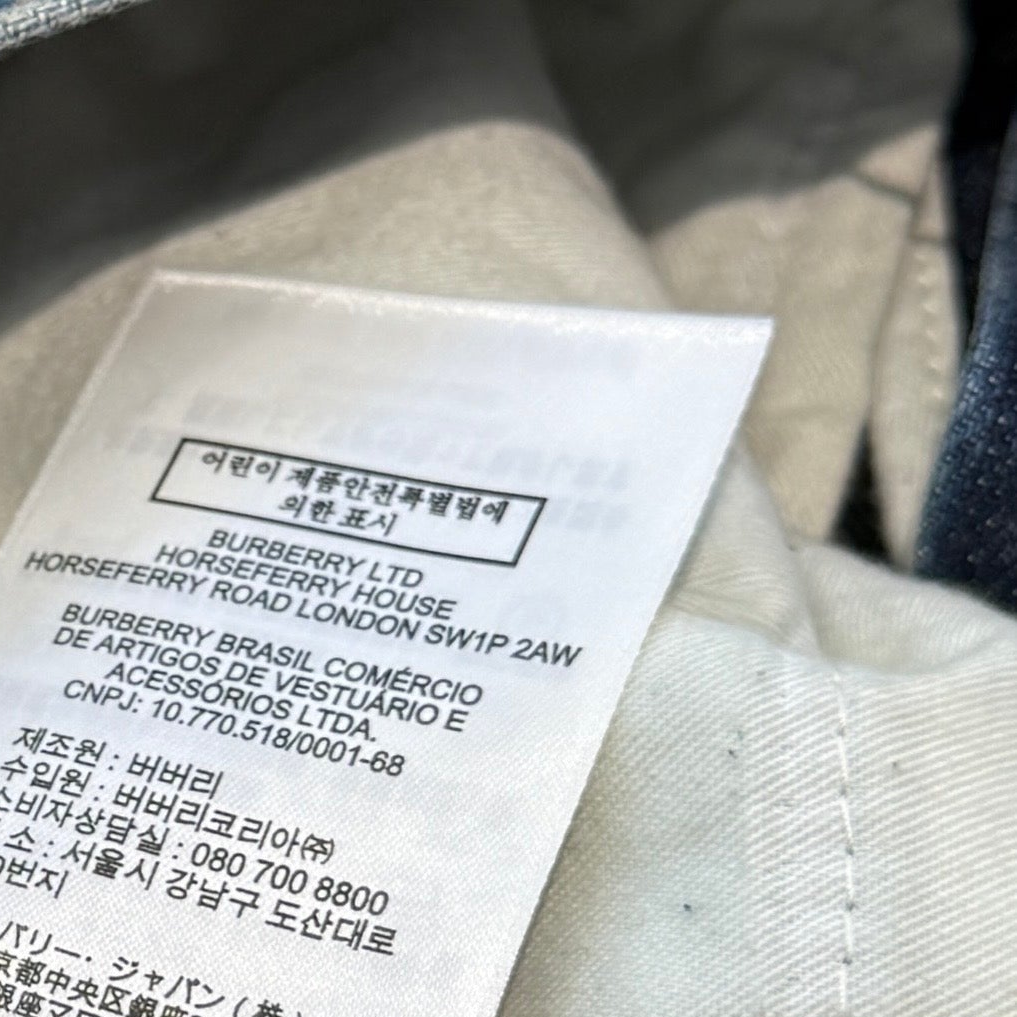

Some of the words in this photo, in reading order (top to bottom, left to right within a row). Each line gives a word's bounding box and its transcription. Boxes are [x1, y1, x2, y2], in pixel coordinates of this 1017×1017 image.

[201, 450, 281, 484] 어린이
[279, 495, 337, 523] 의한
[338, 505, 397, 537] 표시
[154, 544, 351, 599] HORSEFERRY
[353, 585, 457, 620] HOUSE
[207, 529, 366, 575] BURBERRY
[366, 562, 424, 588] LTD
[24, 551, 209, 595] HORSEFERRY
[210, 581, 292, 613] ROAD
[295, 600, 429, 641] LONDON
[424, 624, 509, 655] SW1P
[509, 639, 582, 667] 2AW
[52, 627, 91, 649] DE
[92, 636, 226, 680] ARTIGOS
[230, 663, 272, 686] DE
[274, 672, 442, 726] VESTUÁRIO
[444, 711, 469, 732] E
[60, 603, 214, 647] BURBERRY
[216, 634, 314, 671] BRASIL
[323, 656, 483, 706] COMÉRCIO
[63, 679, 144, 713] CNPJ:
[150, 698, 407, 778] 10.770.518/0001-68
[103, 661, 293, 720] ACESSÓRIOS
[296, 706, 377, 742] LTDA.
[0, 756, 91, 797] 수입원
[13, 726, 107, 769] 제조원
[126, 753, 224, 798] 버버리
[4, 826, 37, 854] 소
[61, 839, 161, 890] 서울시
[165, 868, 262, 919] 강남구
[266, 899, 398, 956] 도산대로
[191, 843, 246, 877] 080
[254, 861, 309, 894] 700
[314, 877, 390, 917] 8800
